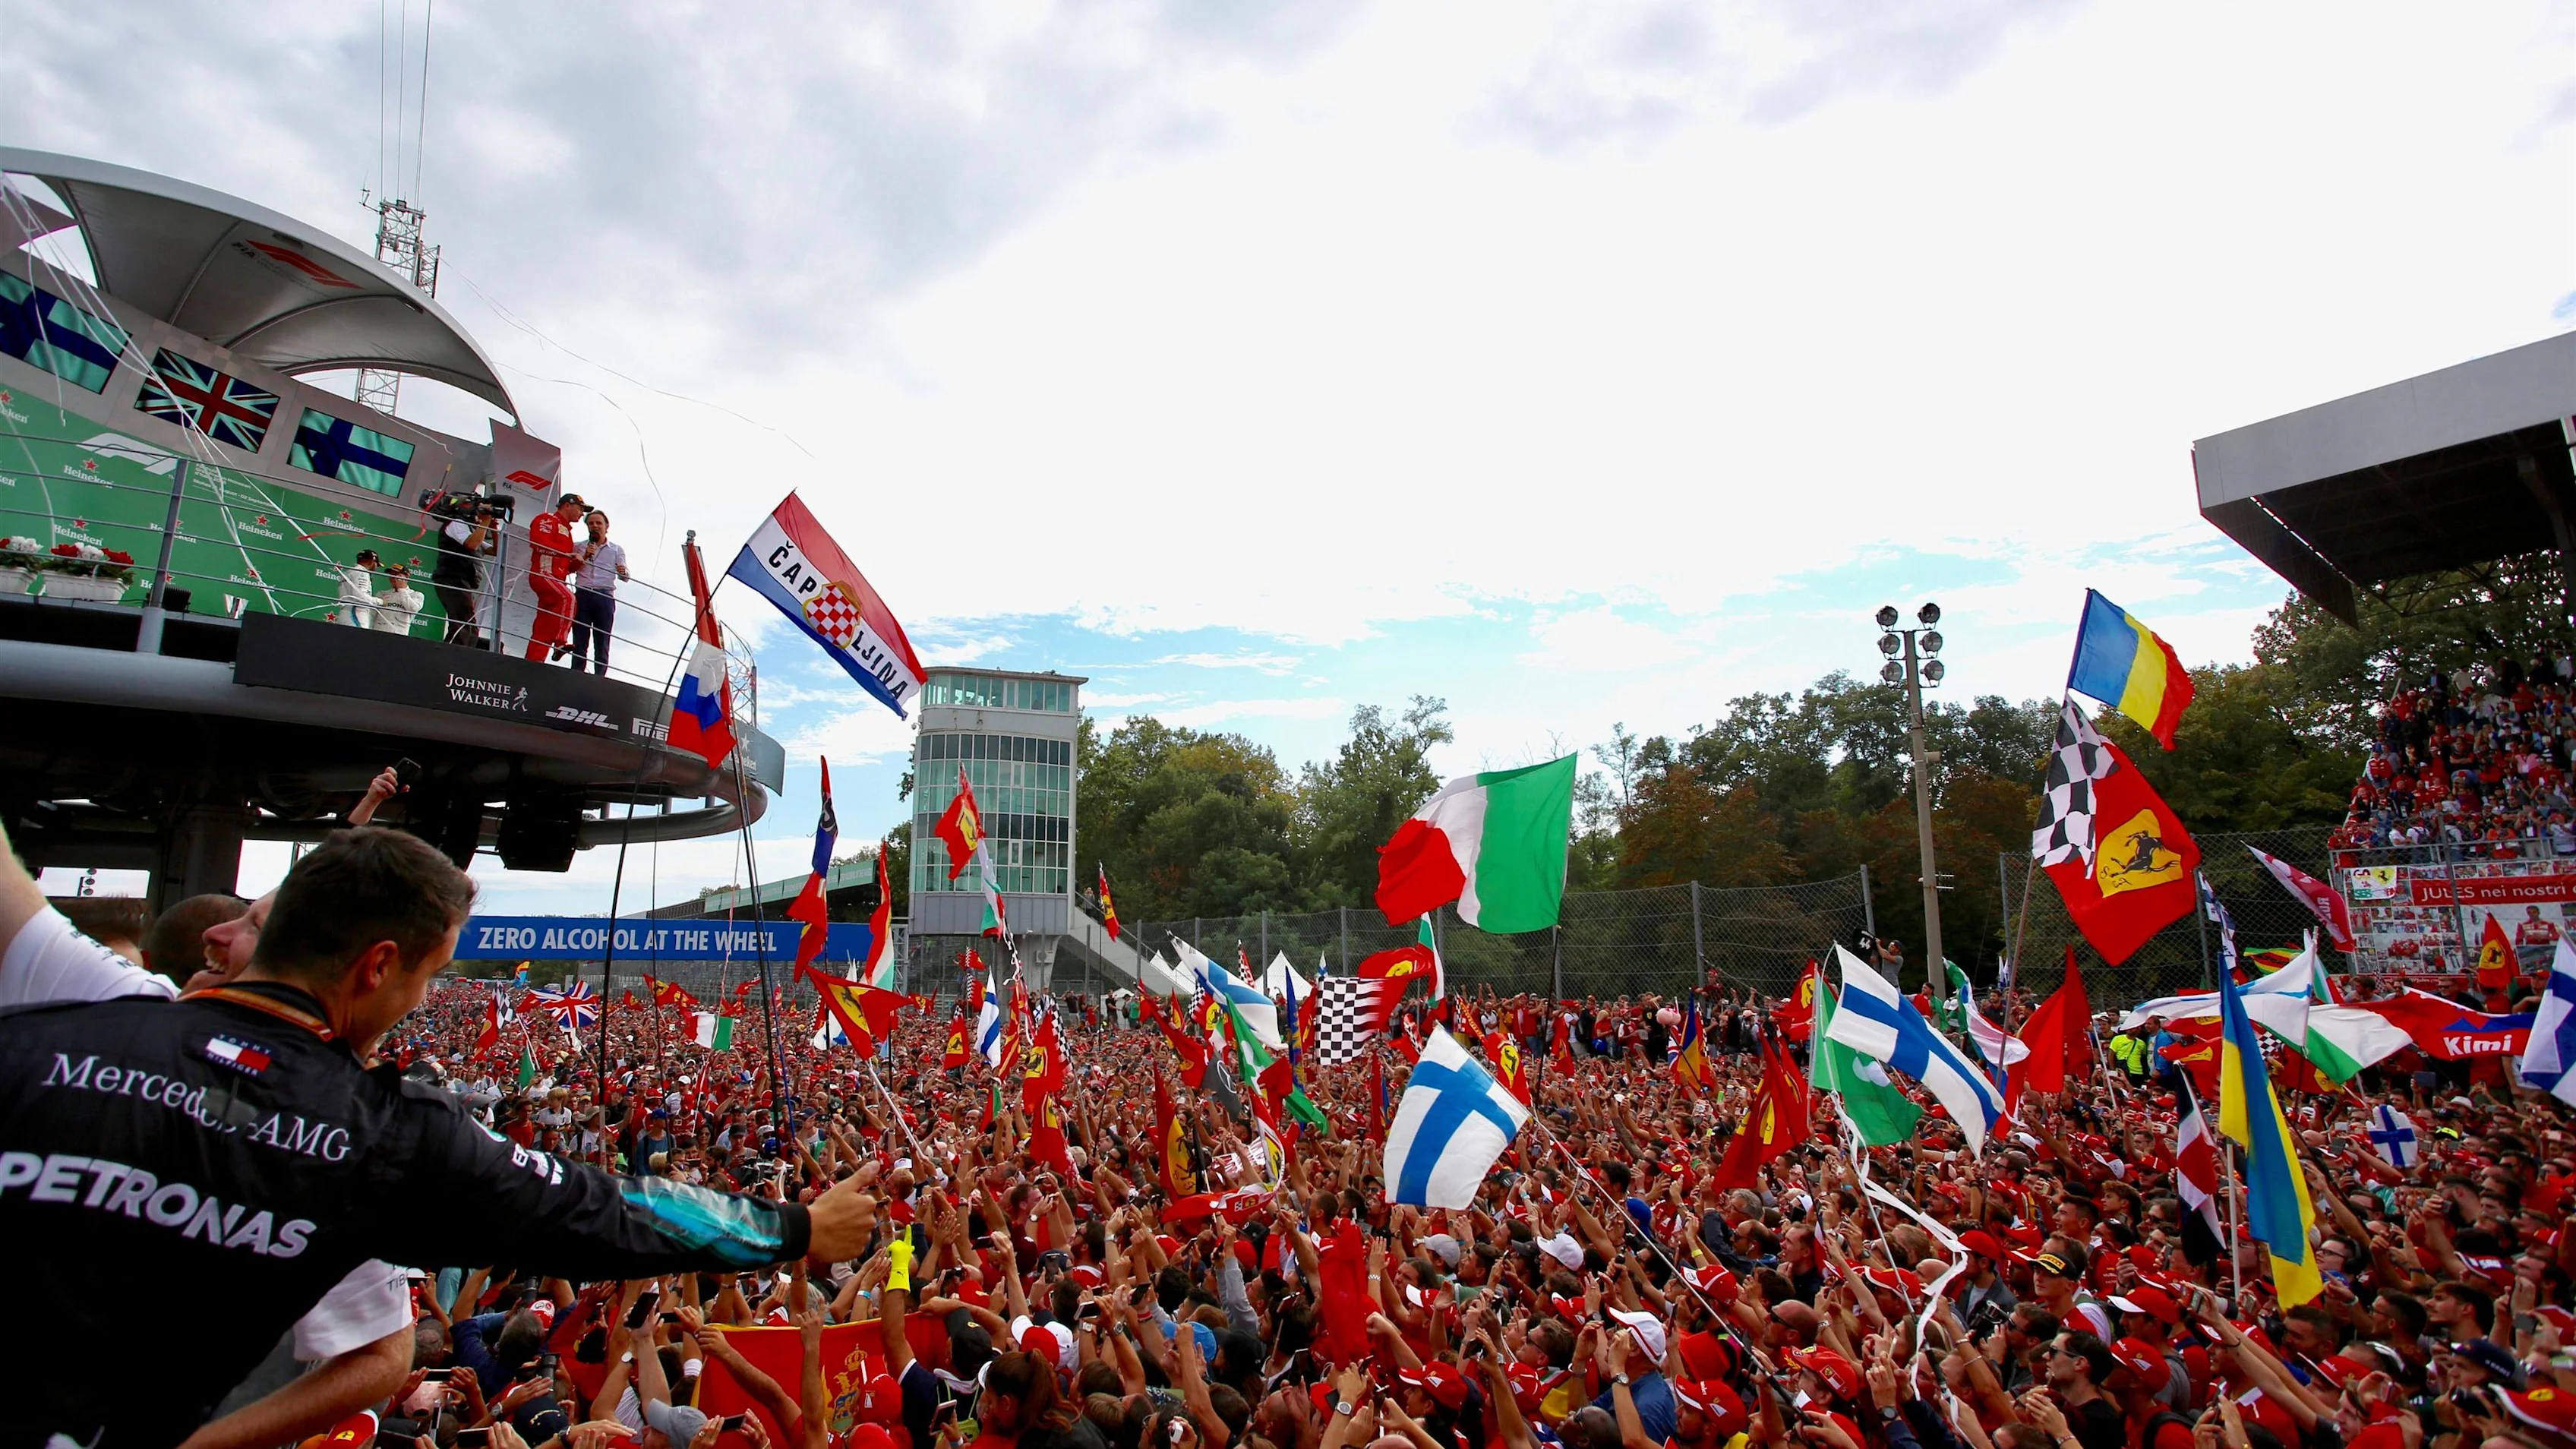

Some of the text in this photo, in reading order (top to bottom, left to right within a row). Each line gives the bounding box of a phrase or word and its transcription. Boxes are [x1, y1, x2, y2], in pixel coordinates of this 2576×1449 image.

[53, 523, 102, 546] Heineken
[238, 522, 283, 541] Heineken
[446, 673, 511, 695] JOHNNIE
[450, 689, 510, 709] WALKER
[553, 706, 611, 728] DHL
[2421, 886, 2475, 902] JULES
[2480, 884, 2507, 898] nei
[2512, 882, 2566, 897] nostri
[477, 927, 777, 952] ZERO ALCOHOL AT THE WHEEL
[219, 1033, 272, 1056] TOMMY
[2442, 1034, 2513, 1057] Kimi
[207, 1052, 259, 1076] HILFIGER
[0, 1151, 317, 1258] PETRONAS
[386, 1272, 407, 1292] TIB
